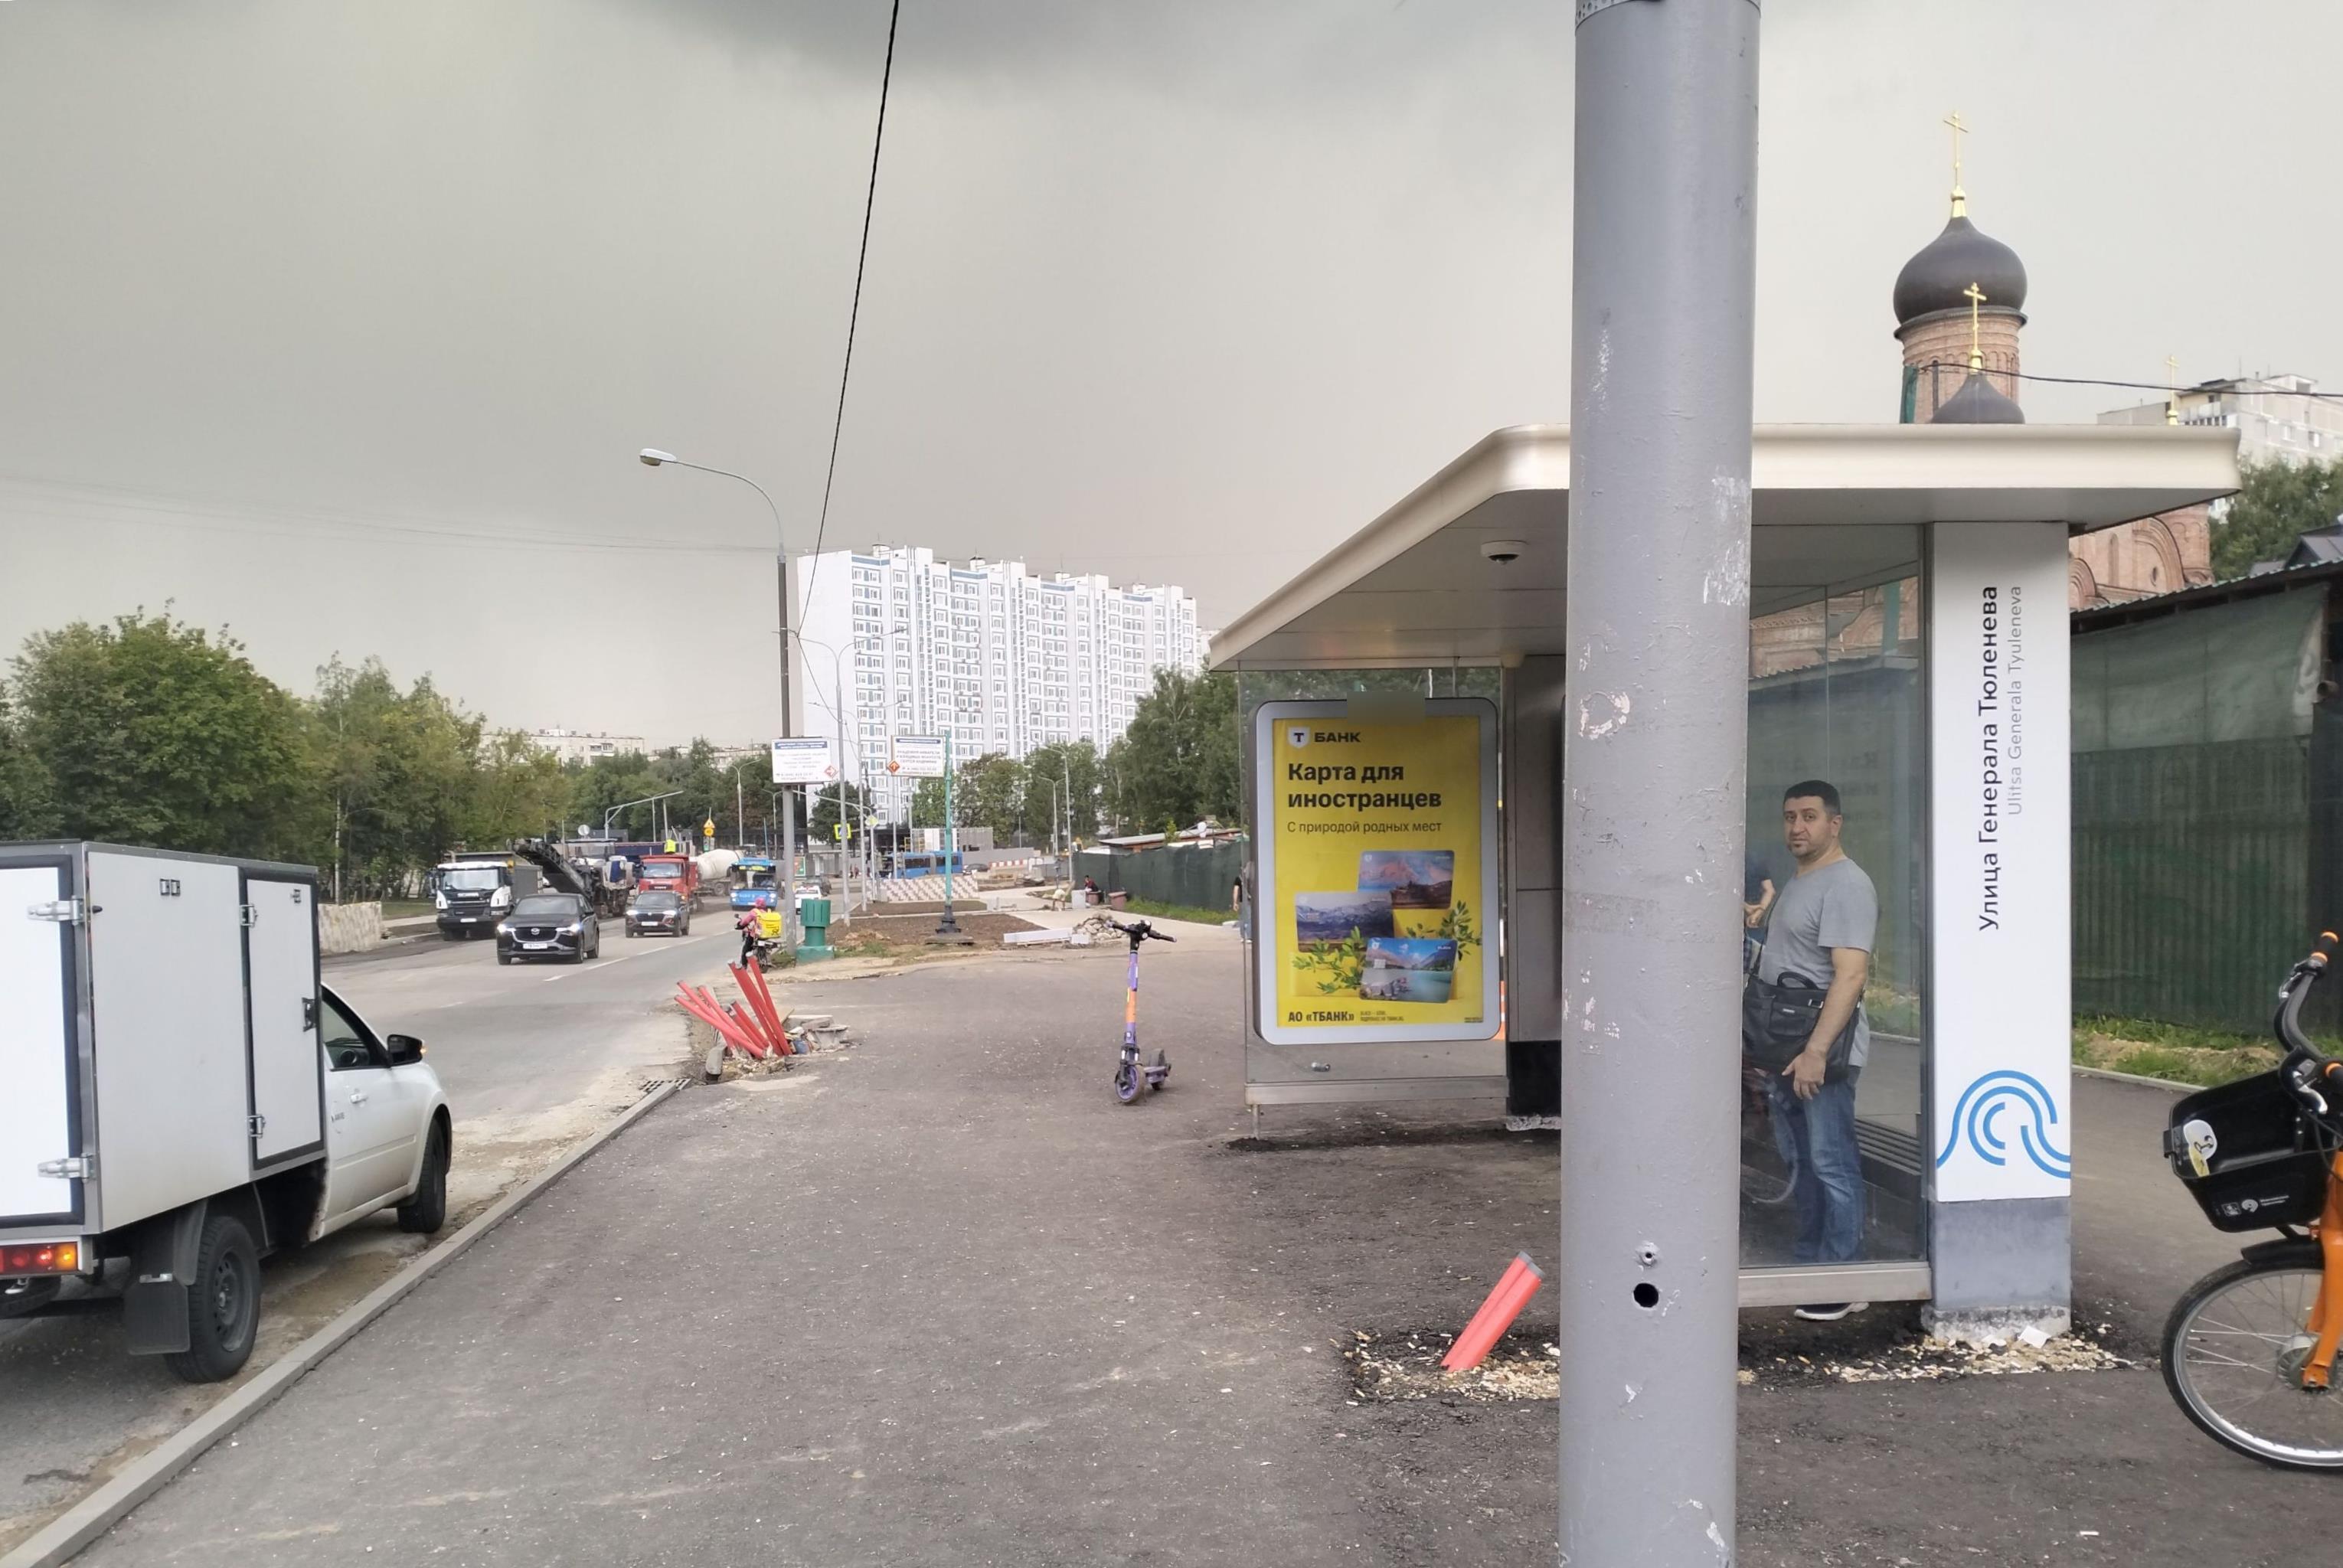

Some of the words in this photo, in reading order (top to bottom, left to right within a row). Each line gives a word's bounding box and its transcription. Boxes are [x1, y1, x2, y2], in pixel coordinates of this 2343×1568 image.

[1978, 586, 1997, 717] Тюленева
[2007, 586, 2024, 674] Tyuleneva
[1314, 732, 1361, 743] БАНК
[2007, 681, 2022, 759] Generala
[1288, 763, 1356, 785] Карта
[1361, 766, 1404, 784] для
[1979, 724, 2002, 842] Генерала
[2007, 767, 2022, 815] Ulitsa
[1288, 792, 1442, 812] иностранцев
[1287, 822, 1296, 832] С
[1299, 822, 1360, 834] природой
[1363, 822, 1410, 835] родных
[1412, 822, 1442, 832] мест
[1979, 853, 2001, 931] Улица
[1288, 1011, 1302, 1022] АО
[1305, 1011, 1354, 1022] «ТБАНК»
